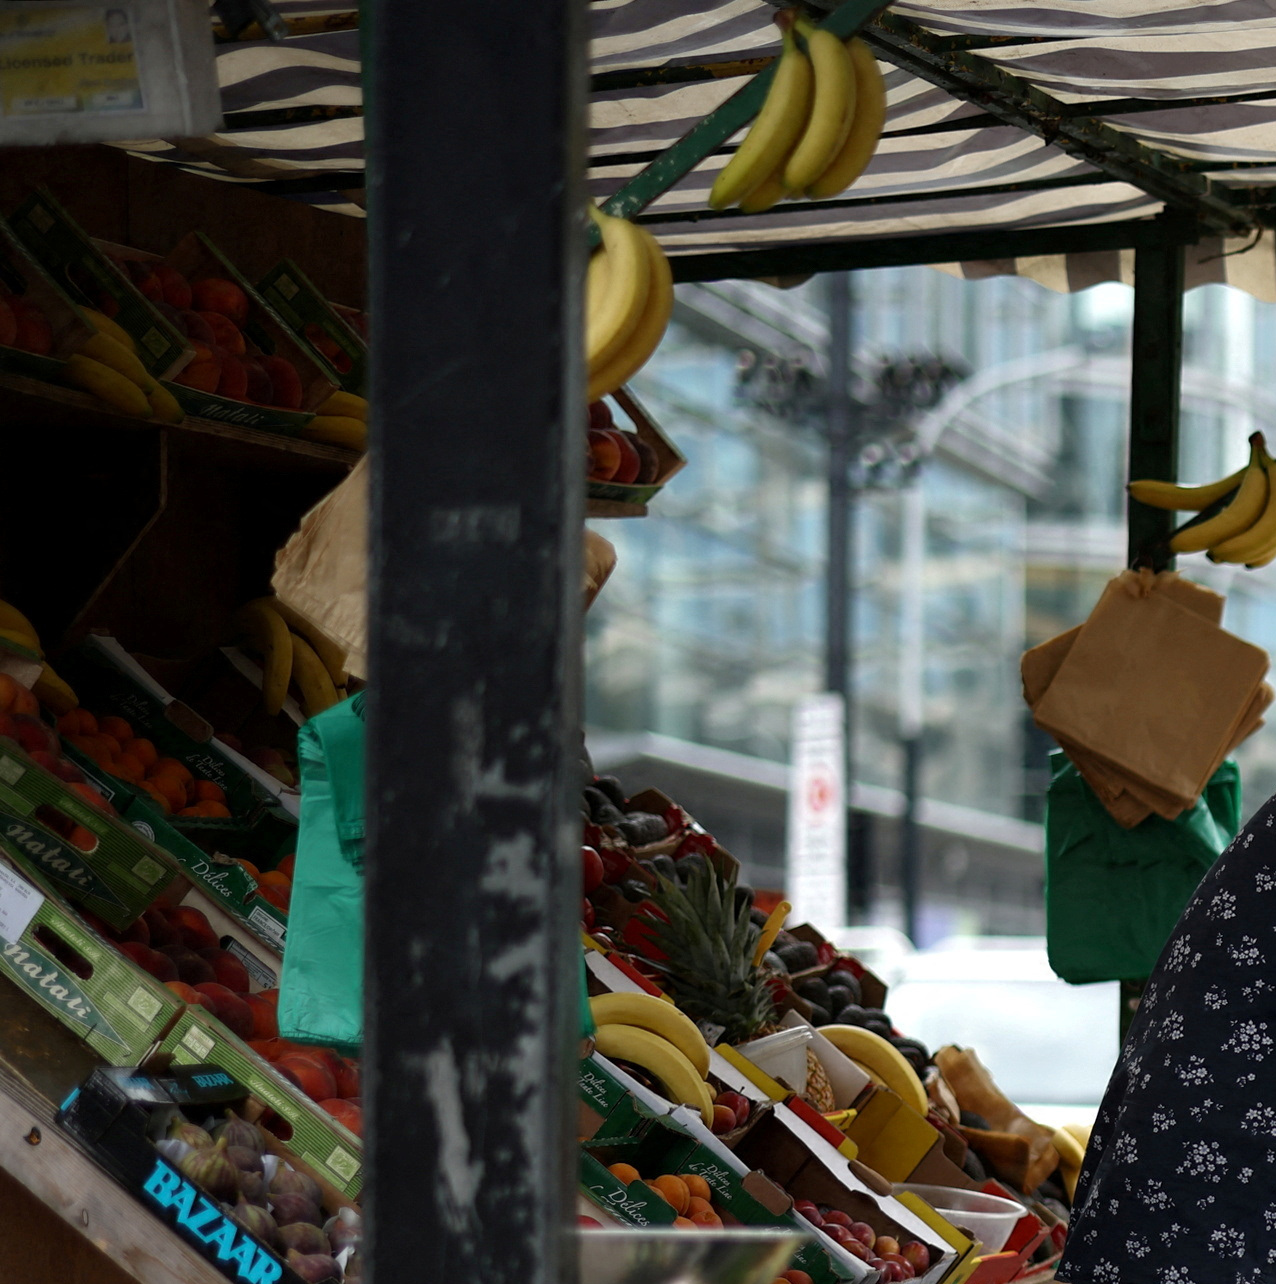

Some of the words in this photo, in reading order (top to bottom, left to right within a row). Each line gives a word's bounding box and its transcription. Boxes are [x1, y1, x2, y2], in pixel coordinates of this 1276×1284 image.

[79, 51, 134, 65] Trader
[190, 858, 233, 899] Délices
[706, 1163, 731, 1187] Délices
[608, 1186, 651, 1227] Délices
